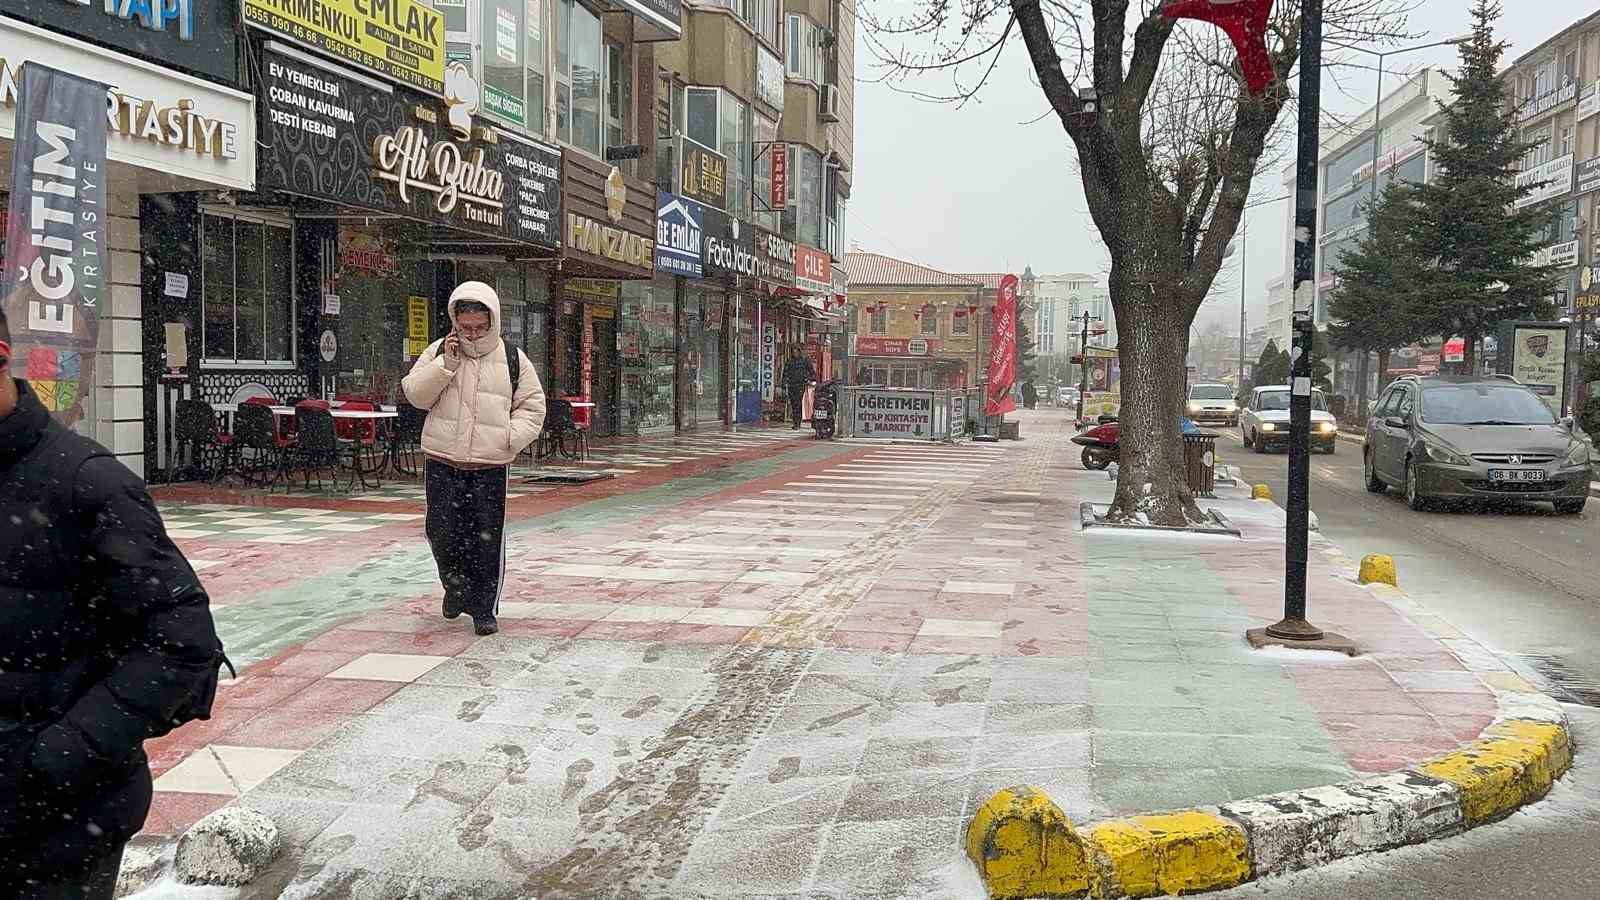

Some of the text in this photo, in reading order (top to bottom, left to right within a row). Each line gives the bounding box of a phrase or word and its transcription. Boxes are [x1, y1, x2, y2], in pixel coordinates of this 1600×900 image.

[245, 5, 268, 23] 0555
[271, 15, 290, 32] 090
[325, 38, 346, 56] 0542
[391, 66, 409, 81] 0542
[269, 62, 340, 98] EV YEMEKLERİ
[269, 86, 355, 124] ÇOBAN KAVURMA
[270, 108, 337, 139] DESTİ KEBABI
[378, 126, 504, 213] Ali Baba
[505, 152, 528, 170] ÇORBA
[19, 120, 76, 334] EĞİTİM
[465, 203, 503, 226] Tantuni
[80, 160, 97, 307] KIRTASİYE
[567, 212, 654, 269] HANZADE
[804, 251, 824, 278] ÇİLE
[858, 394, 930, 411] ÖĞRETMEN
[874, 423, 911, 433] MARKET
[1522, 471, 1543, 480] 9033
